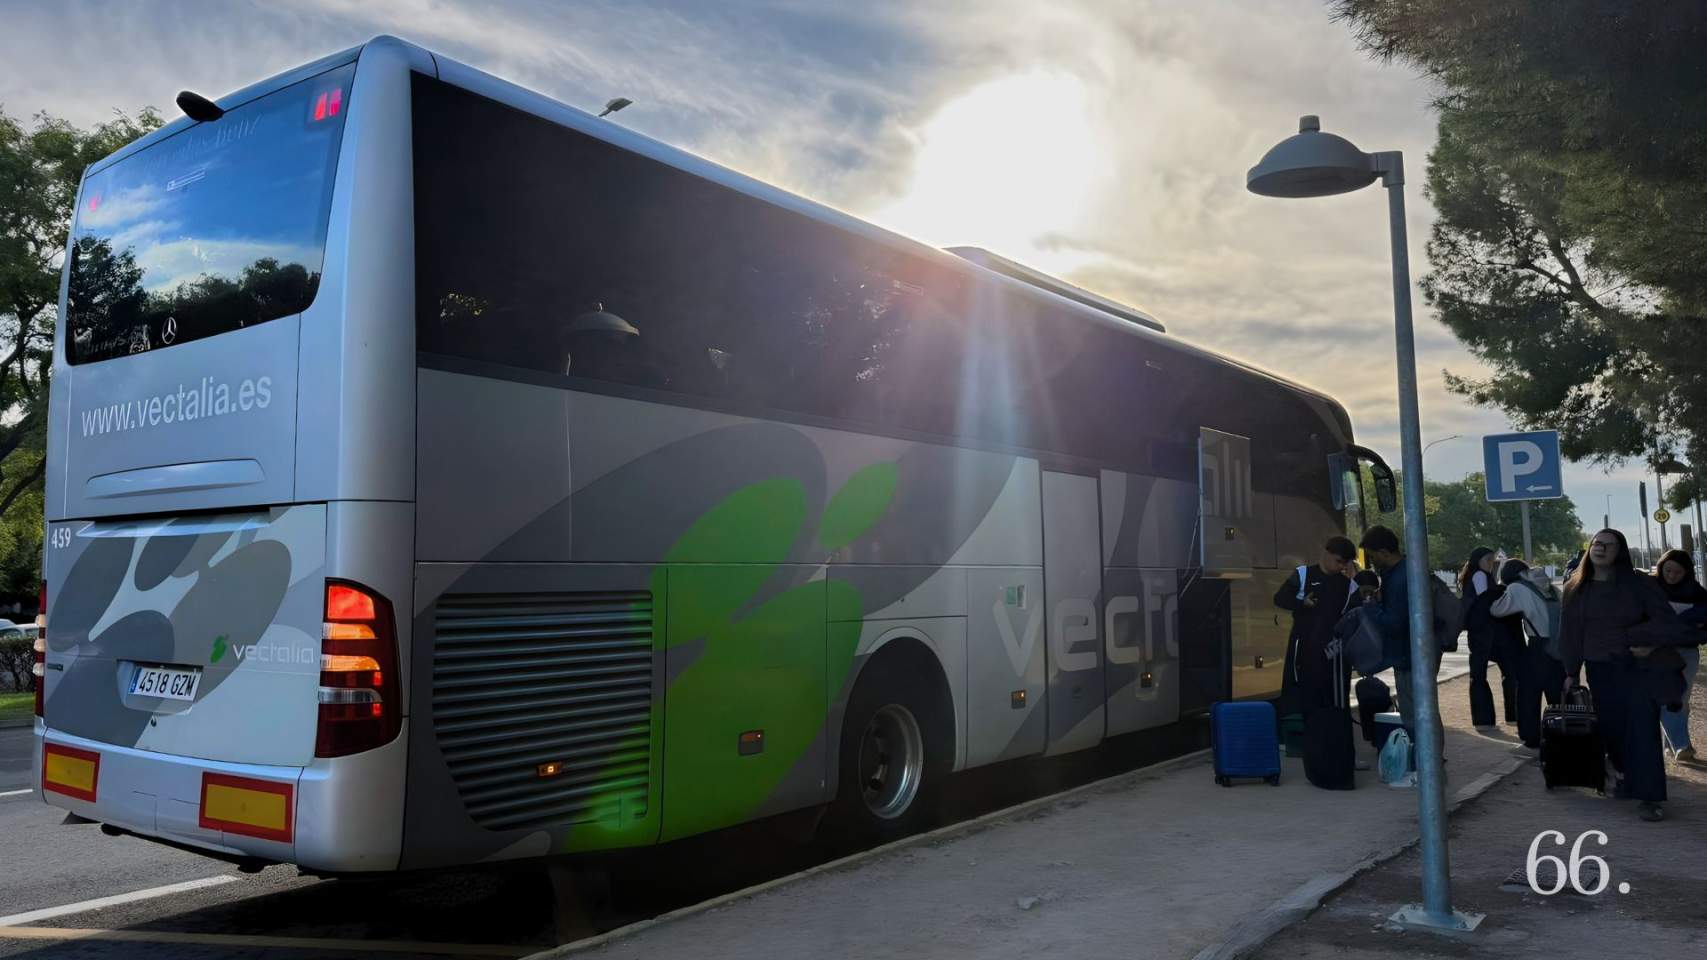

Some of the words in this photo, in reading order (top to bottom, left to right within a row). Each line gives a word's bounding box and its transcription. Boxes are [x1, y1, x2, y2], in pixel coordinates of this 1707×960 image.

[82, 376, 272, 437] www.vectalia.es
[1497, 440, 1544, 493] P
[51, 527, 72, 549] 459
[232, 641, 315, 664] vectalia
[138, 671, 170, 694] 4518
[170, 674, 197, 697] GZM
